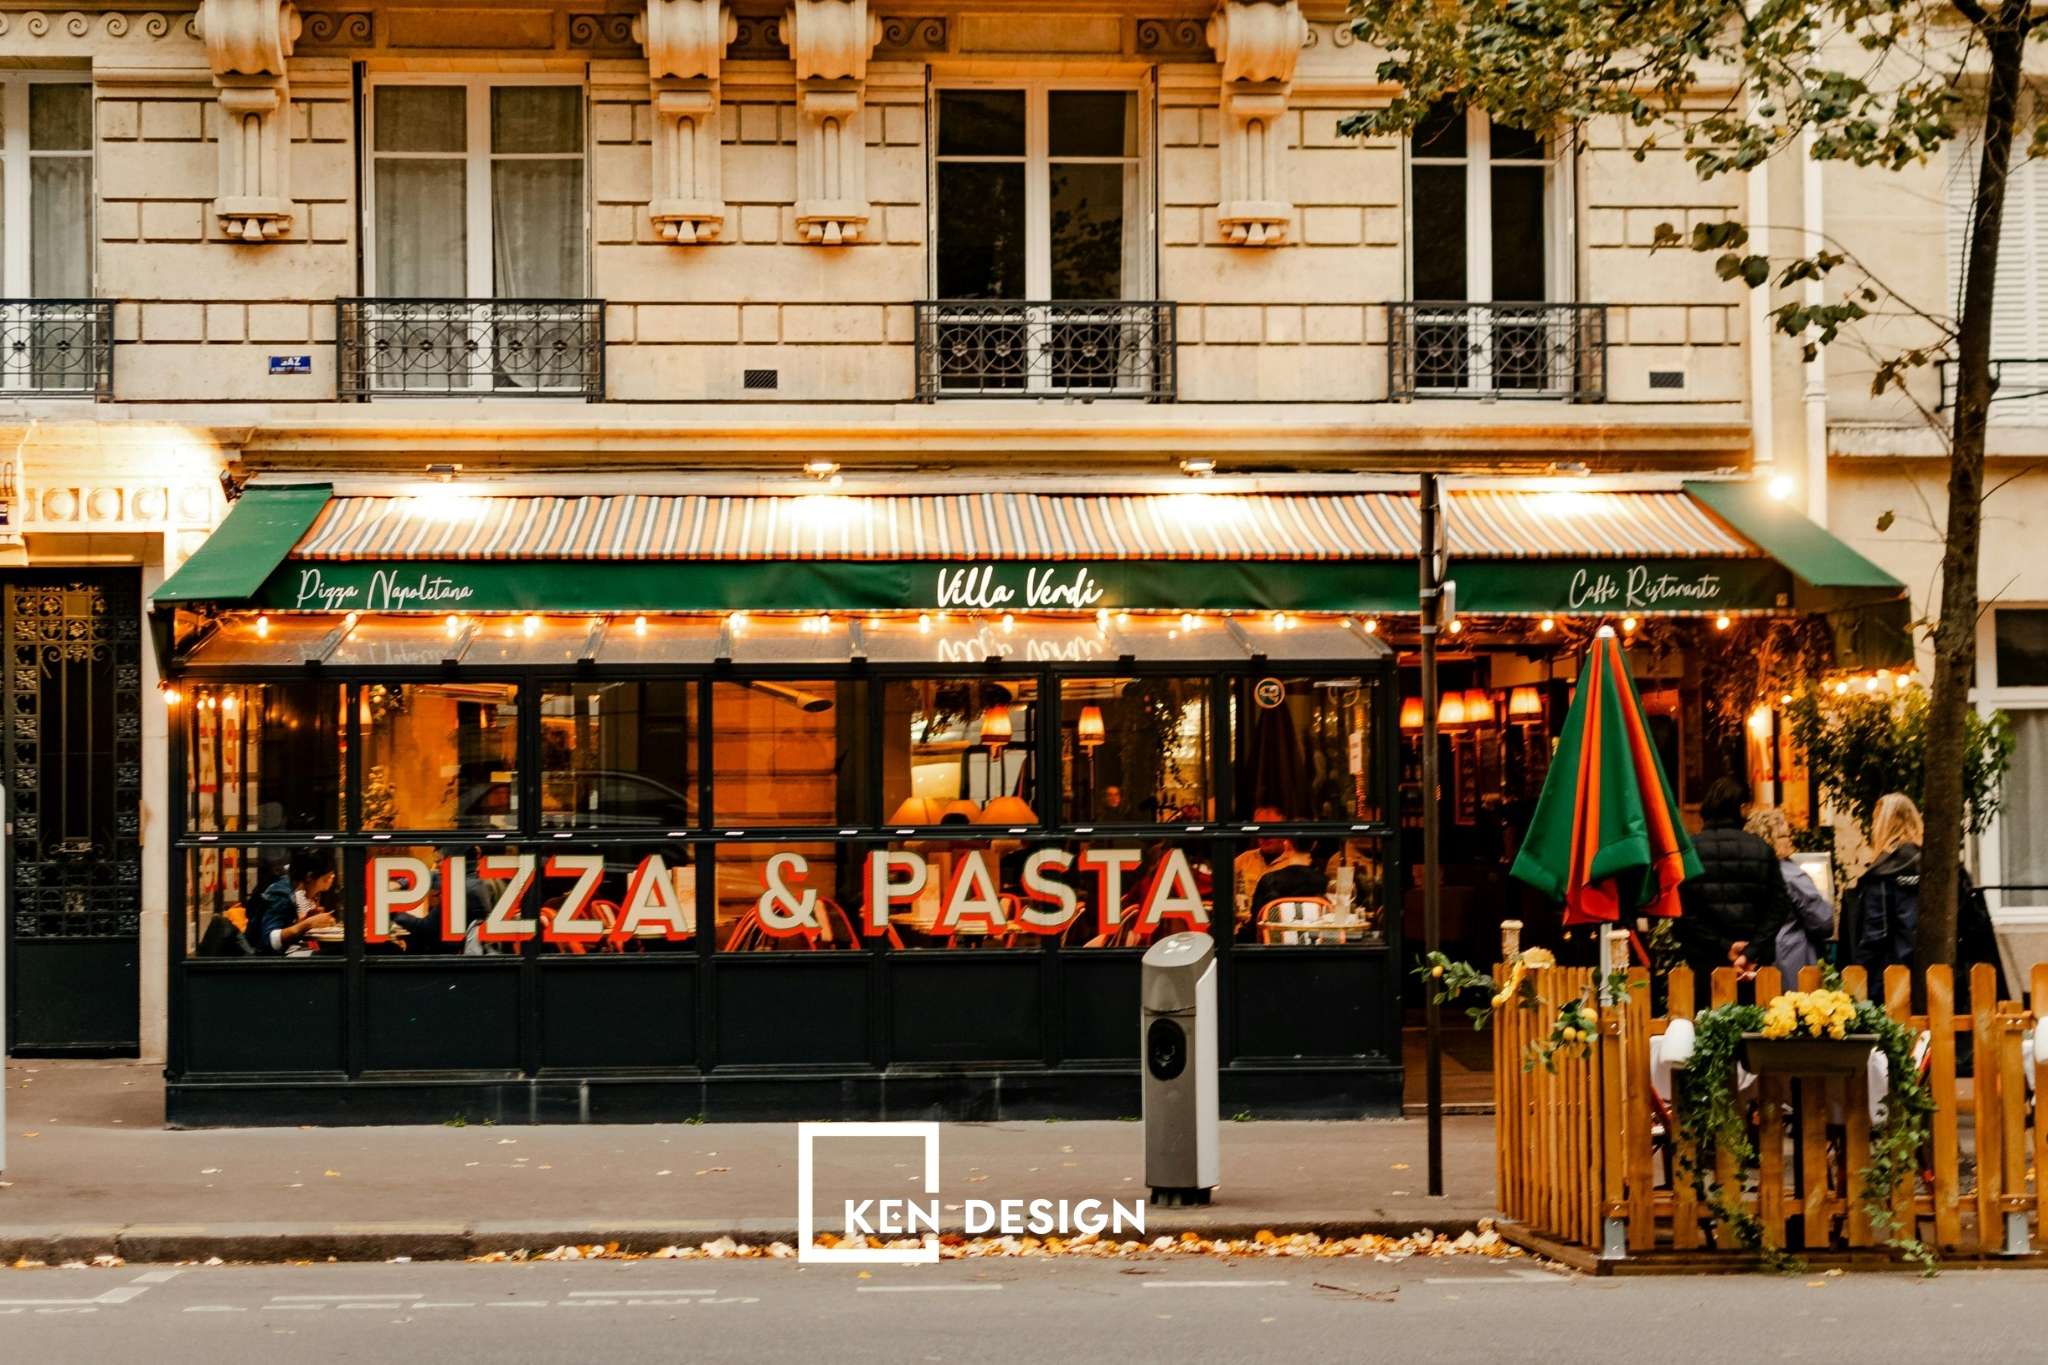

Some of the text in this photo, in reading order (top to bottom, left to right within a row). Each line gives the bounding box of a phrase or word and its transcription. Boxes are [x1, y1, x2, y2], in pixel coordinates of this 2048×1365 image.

[296, 568, 474, 610] Pizza Napoletana
[937, 565, 1104, 608] Villa Verdi
[1626, 565, 1721, 608] Ristorante
[364, 848, 1211, 943] PIZZA & PASTA
